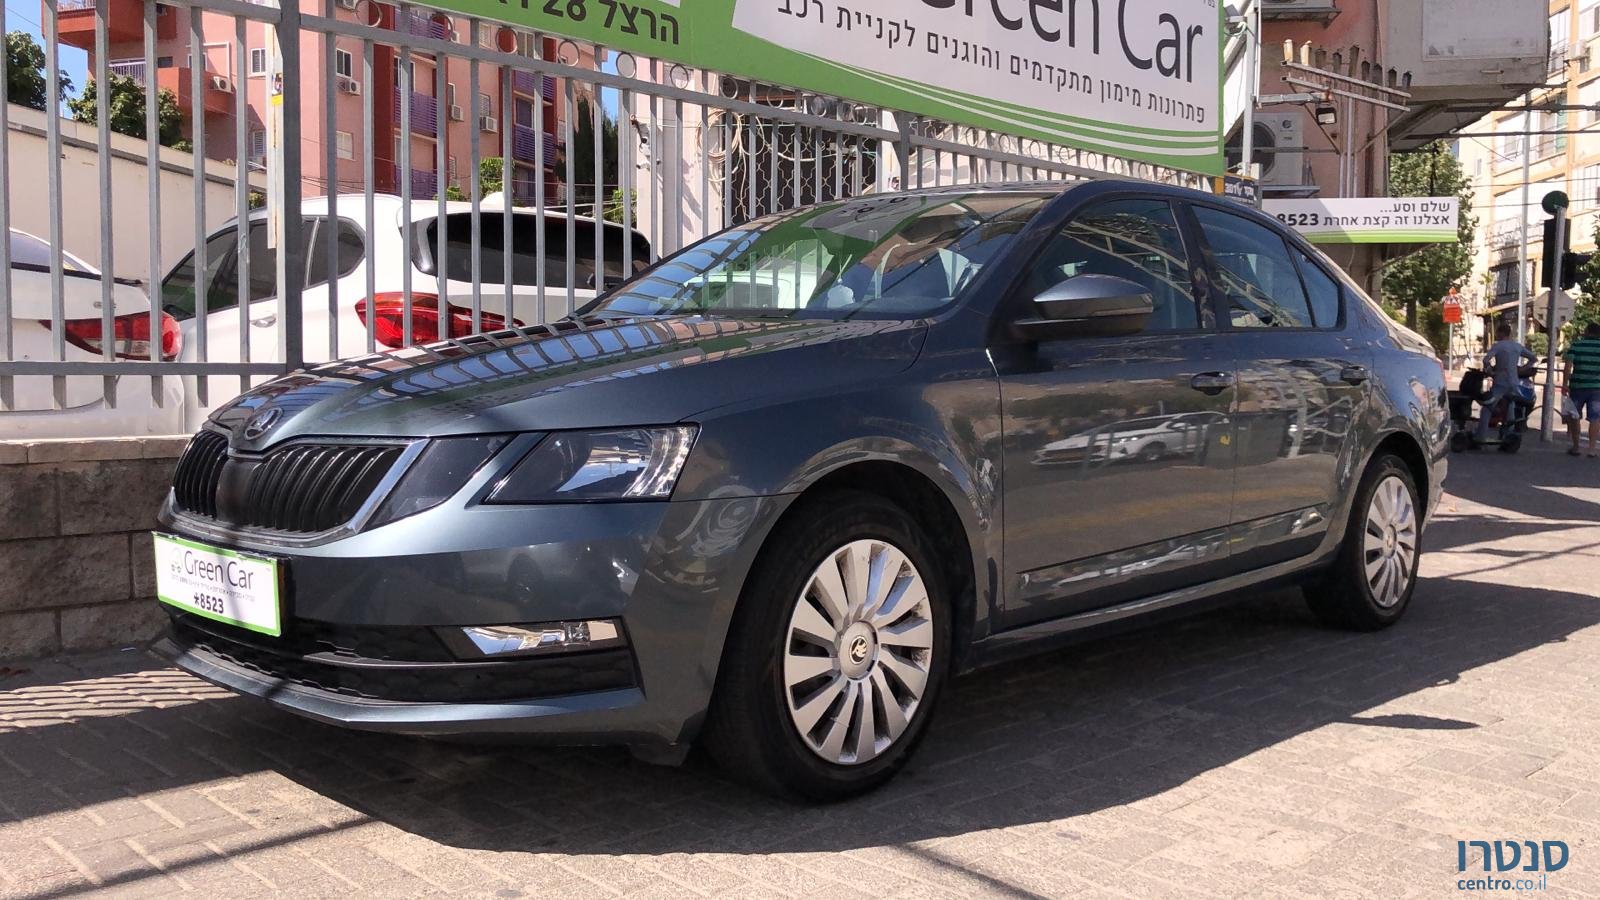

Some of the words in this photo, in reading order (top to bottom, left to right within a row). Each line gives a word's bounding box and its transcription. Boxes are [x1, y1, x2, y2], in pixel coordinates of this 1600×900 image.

[600, 0, 679, 45] הרצל
[836, 6, 916, 49] לקניית
[927, 32, 1000, 70] והוגנים
[1118, 0, 1203, 83] Car
[1010, 55, 1092, 94] מתקדמים
[1100, 79, 1141, 107] מימון
[1147, 93, 1205, 123] פתרונות
[1323, 216, 1359, 226] אחרת
[1362, 215, 1390, 227] קצת
[1394, 215, 1409, 225] זה
[1413, 213, 1450, 225] אצלנו
[1420, 201, 1450, 213] שלם
[184, 550, 224, 583] Green
[227, 561, 254, 590] Car
